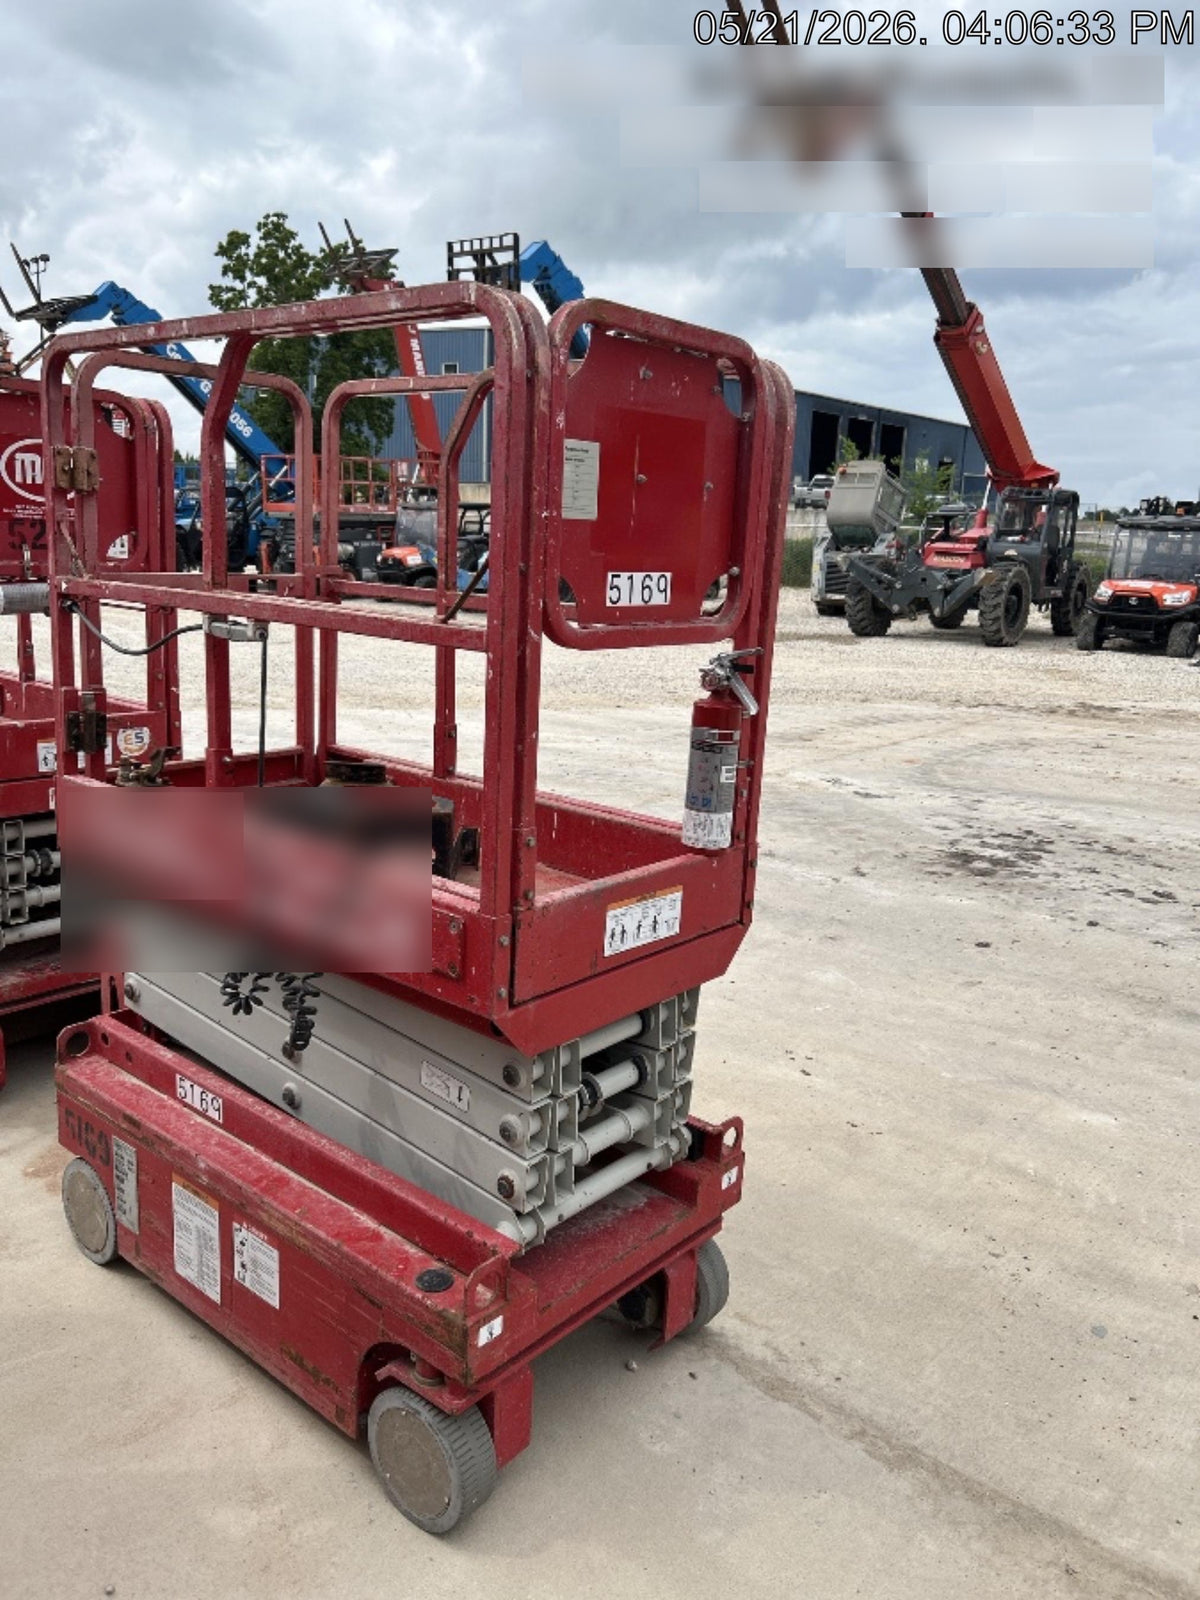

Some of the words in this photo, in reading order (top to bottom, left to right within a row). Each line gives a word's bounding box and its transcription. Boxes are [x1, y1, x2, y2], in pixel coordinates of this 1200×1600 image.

[410, 338, 431, 400] MANIU
[608, 573, 668, 605] 5169
[178, 1076, 221, 1121] 5169
[64, 1106, 111, 1167] 5169
